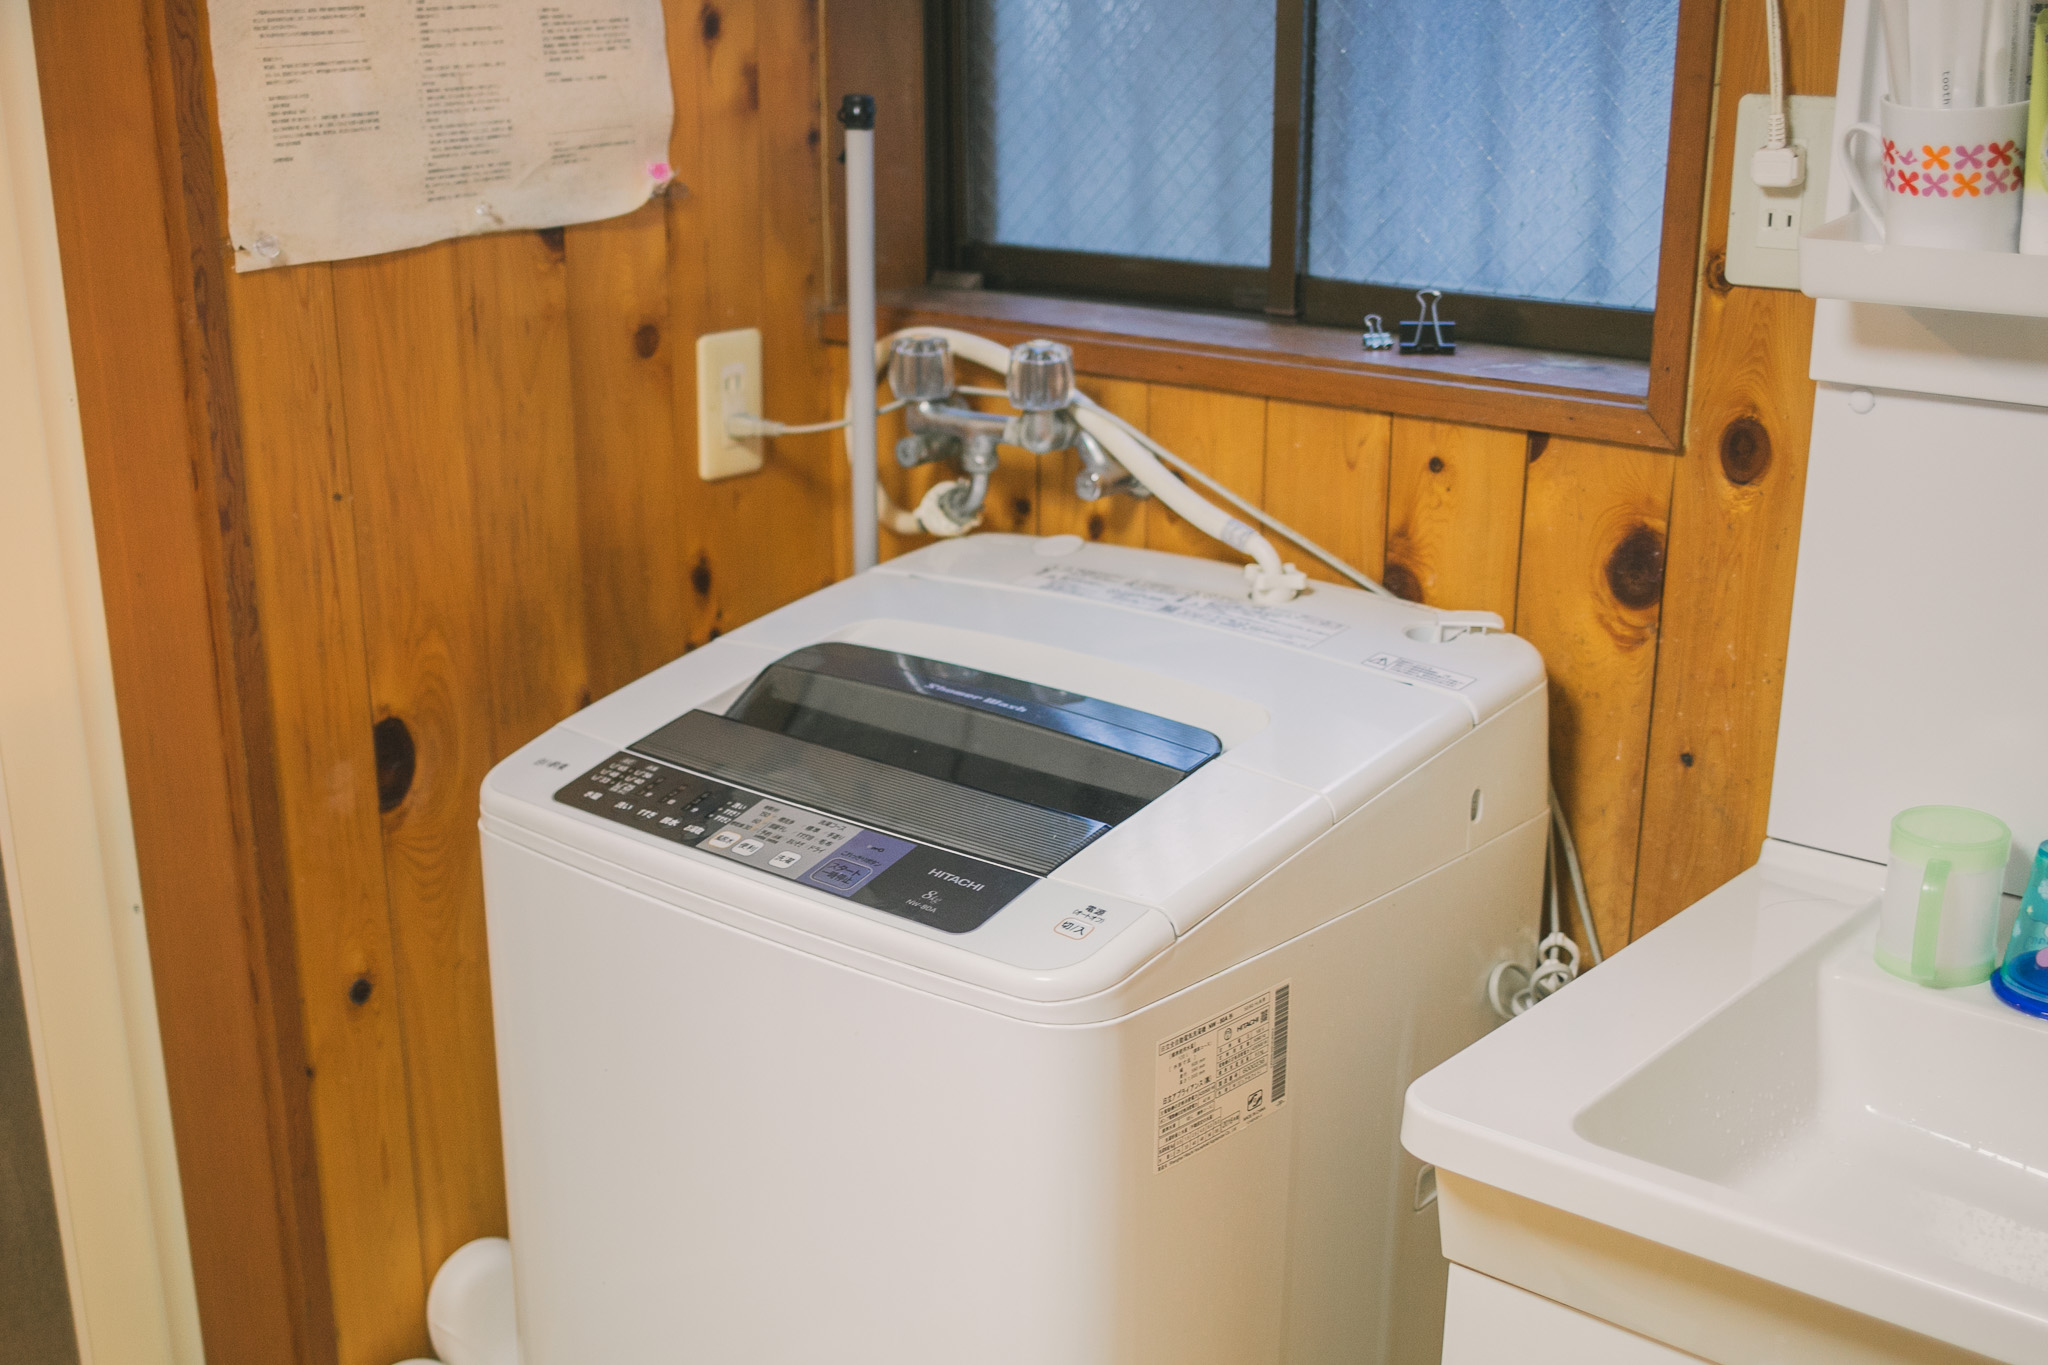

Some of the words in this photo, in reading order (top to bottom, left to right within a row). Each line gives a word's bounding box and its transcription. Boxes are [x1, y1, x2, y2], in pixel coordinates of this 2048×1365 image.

[821, 870, 854, 885] 一時停止
[827, 862, 862, 877] スタート
[928, 867, 986, 892] HITACHI
[905, 898, 937, 914] NW-80A
[1085, 905, 1107, 917] 電源
[1061, 920, 1085, 936] 切/入
[1236, 1016, 1259, 1032] HITACHI
